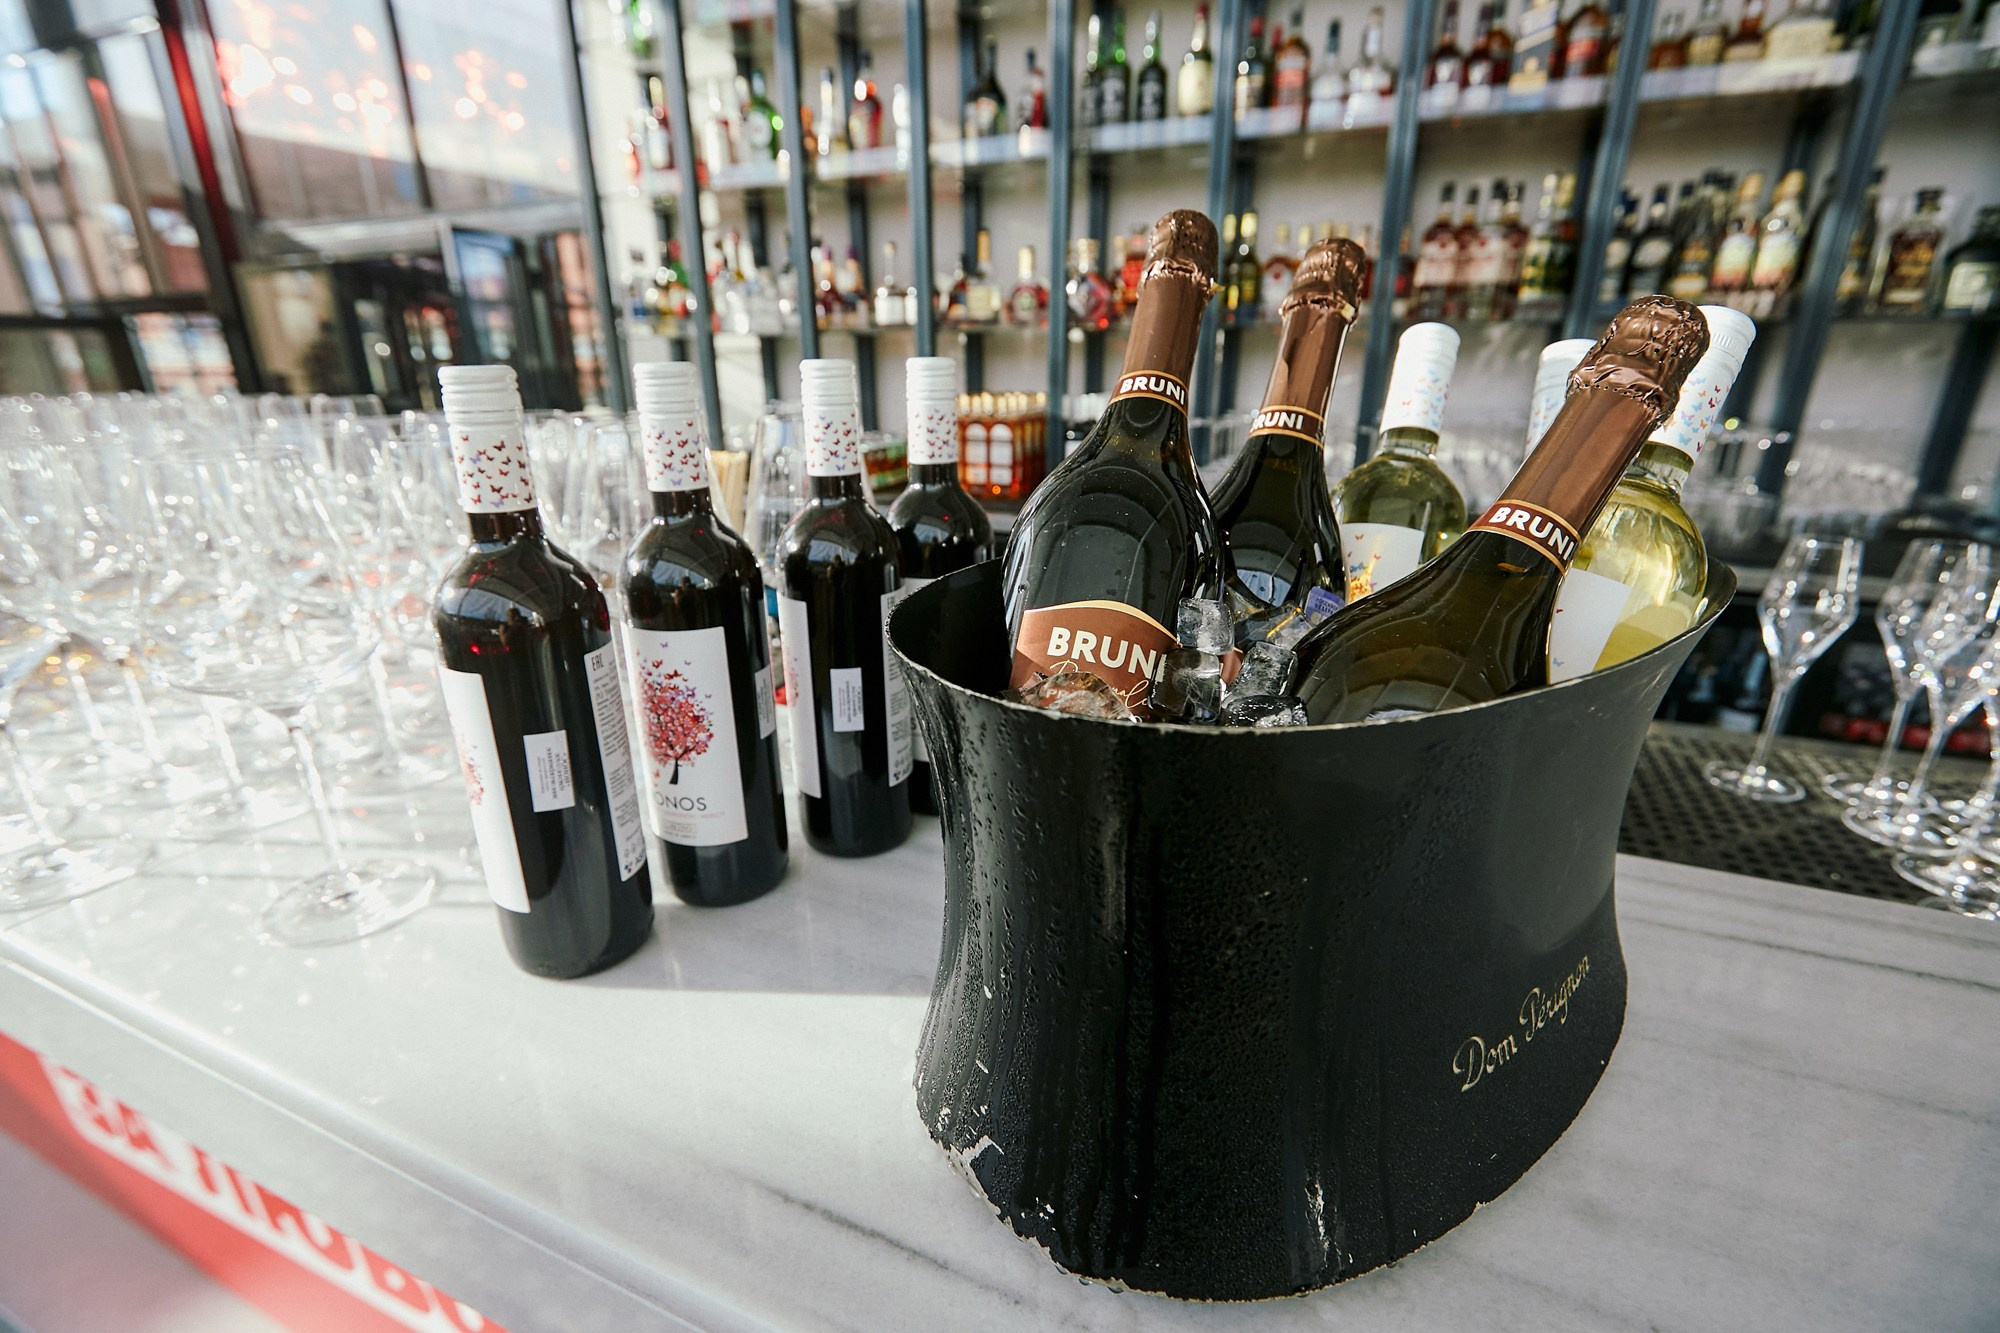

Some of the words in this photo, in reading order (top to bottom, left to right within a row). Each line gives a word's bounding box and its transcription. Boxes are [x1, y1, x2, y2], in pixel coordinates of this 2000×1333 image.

[1119, 376, 1186, 406] BRUNI
[1488, 506, 1575, 562] BRUNI
[1046, 626, 1168, 683] BRUNI
[1452, 1034, 1518, 1093] Dom
[1518, 954, 1591, 1043] Pérignon
